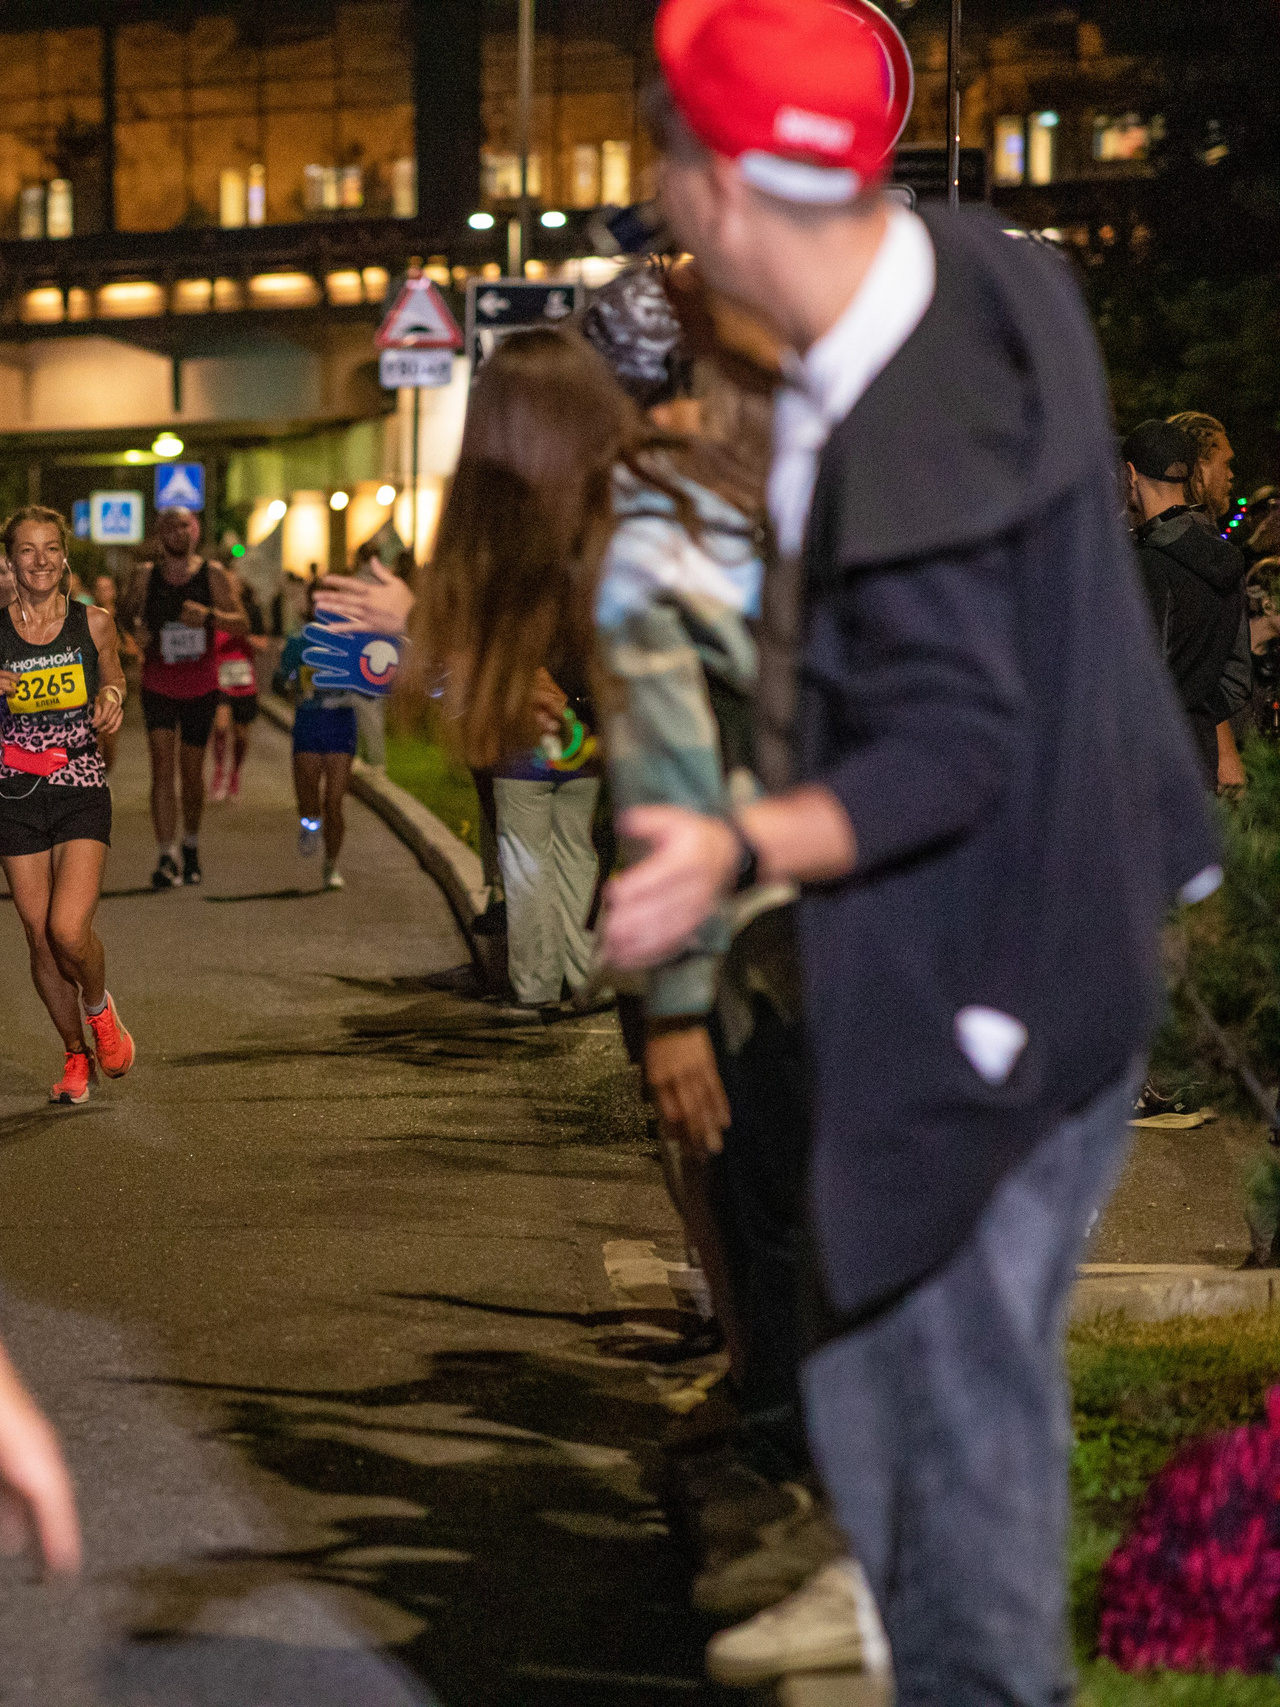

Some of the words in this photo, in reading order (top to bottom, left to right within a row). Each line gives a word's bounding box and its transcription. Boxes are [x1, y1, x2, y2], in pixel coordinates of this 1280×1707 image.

[10, 647, 76, 673] НОЧНОЙ
[16, 671, 75, 701] 3265
[35, 697, 61, 708] ЕЛЕНА
